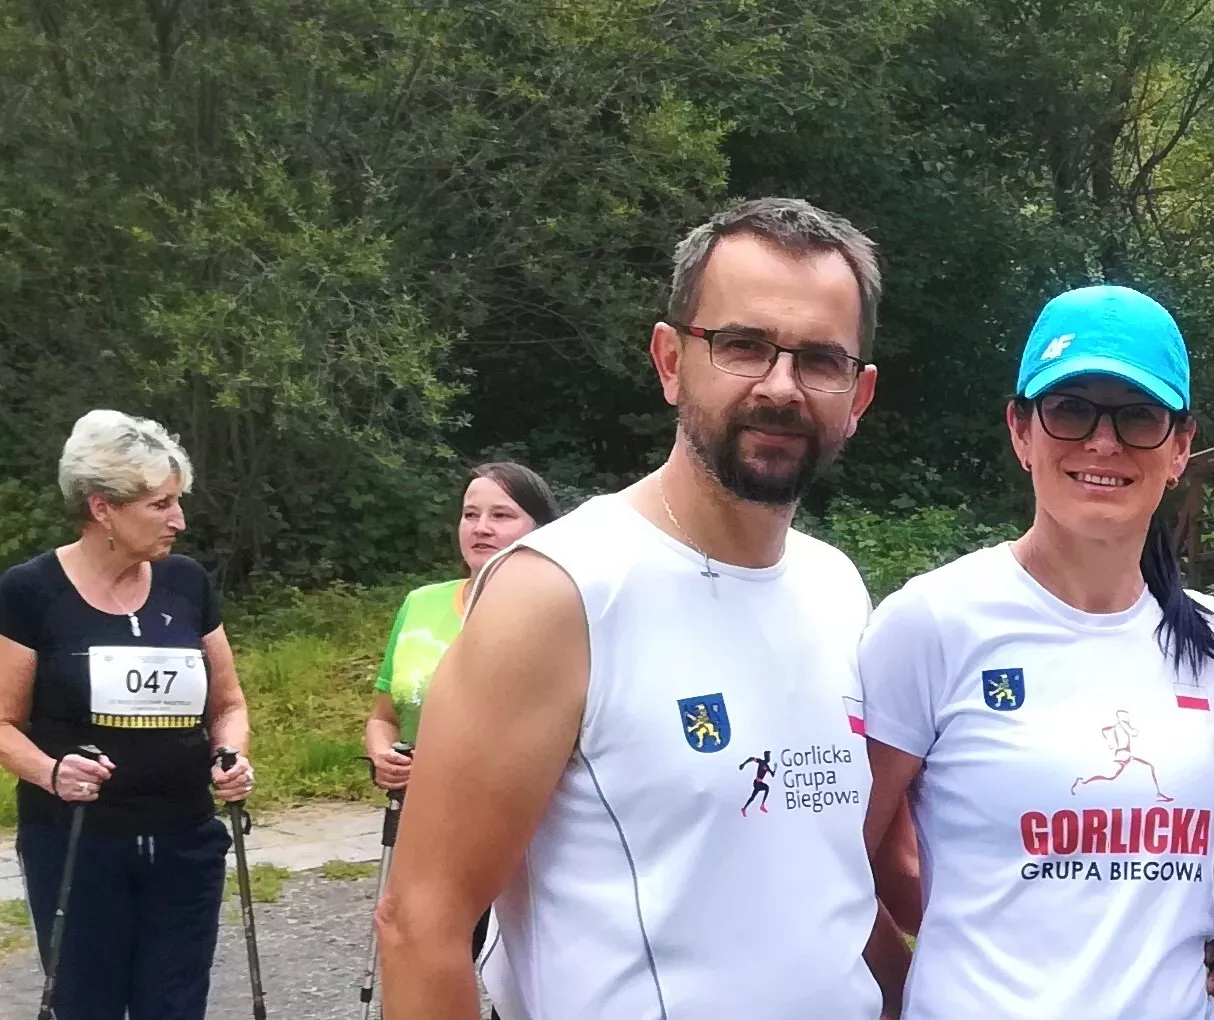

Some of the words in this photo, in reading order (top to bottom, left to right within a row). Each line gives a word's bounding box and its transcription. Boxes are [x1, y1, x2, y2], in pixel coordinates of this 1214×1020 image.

[126, 669, 178, 694] 047
[780, 745, 852, 768] Gorlicka
[783, 770, 836, 790] Grupa
[785, 789, 859, 813] Biegowa
[1020, 807, 1212, 856] GORLICKA
[1021, 861, 1102, 881] GRUPA
[1109, 861, 1203, 882] BIEGOWA
